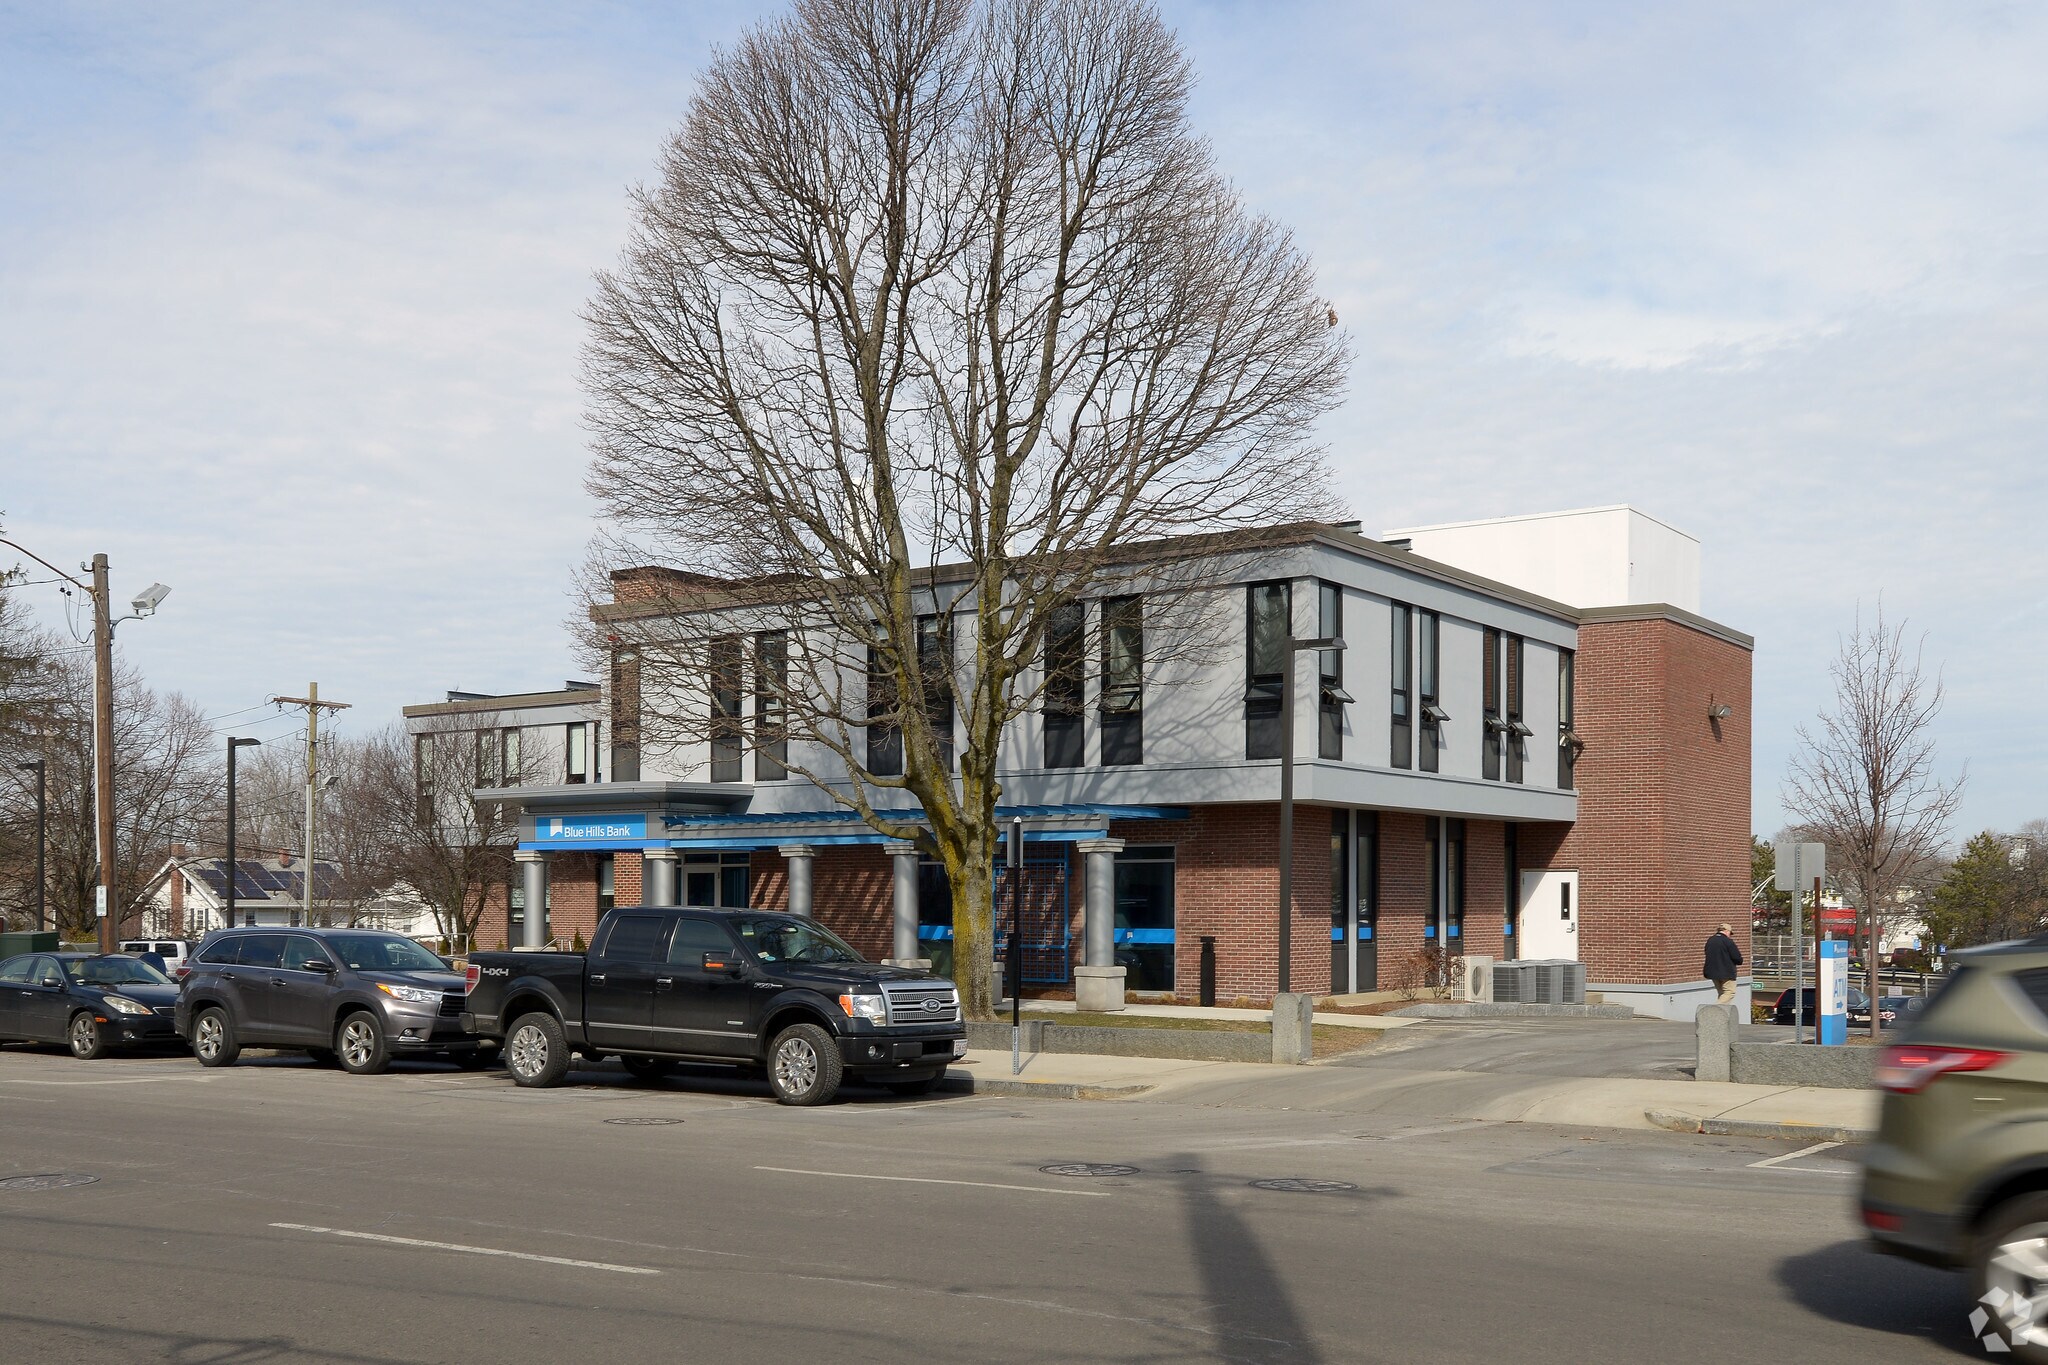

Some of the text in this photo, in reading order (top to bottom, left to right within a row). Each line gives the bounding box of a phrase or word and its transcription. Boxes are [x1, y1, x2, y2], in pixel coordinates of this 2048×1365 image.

[564, 824, 631, 837] Blue Hills Bank
